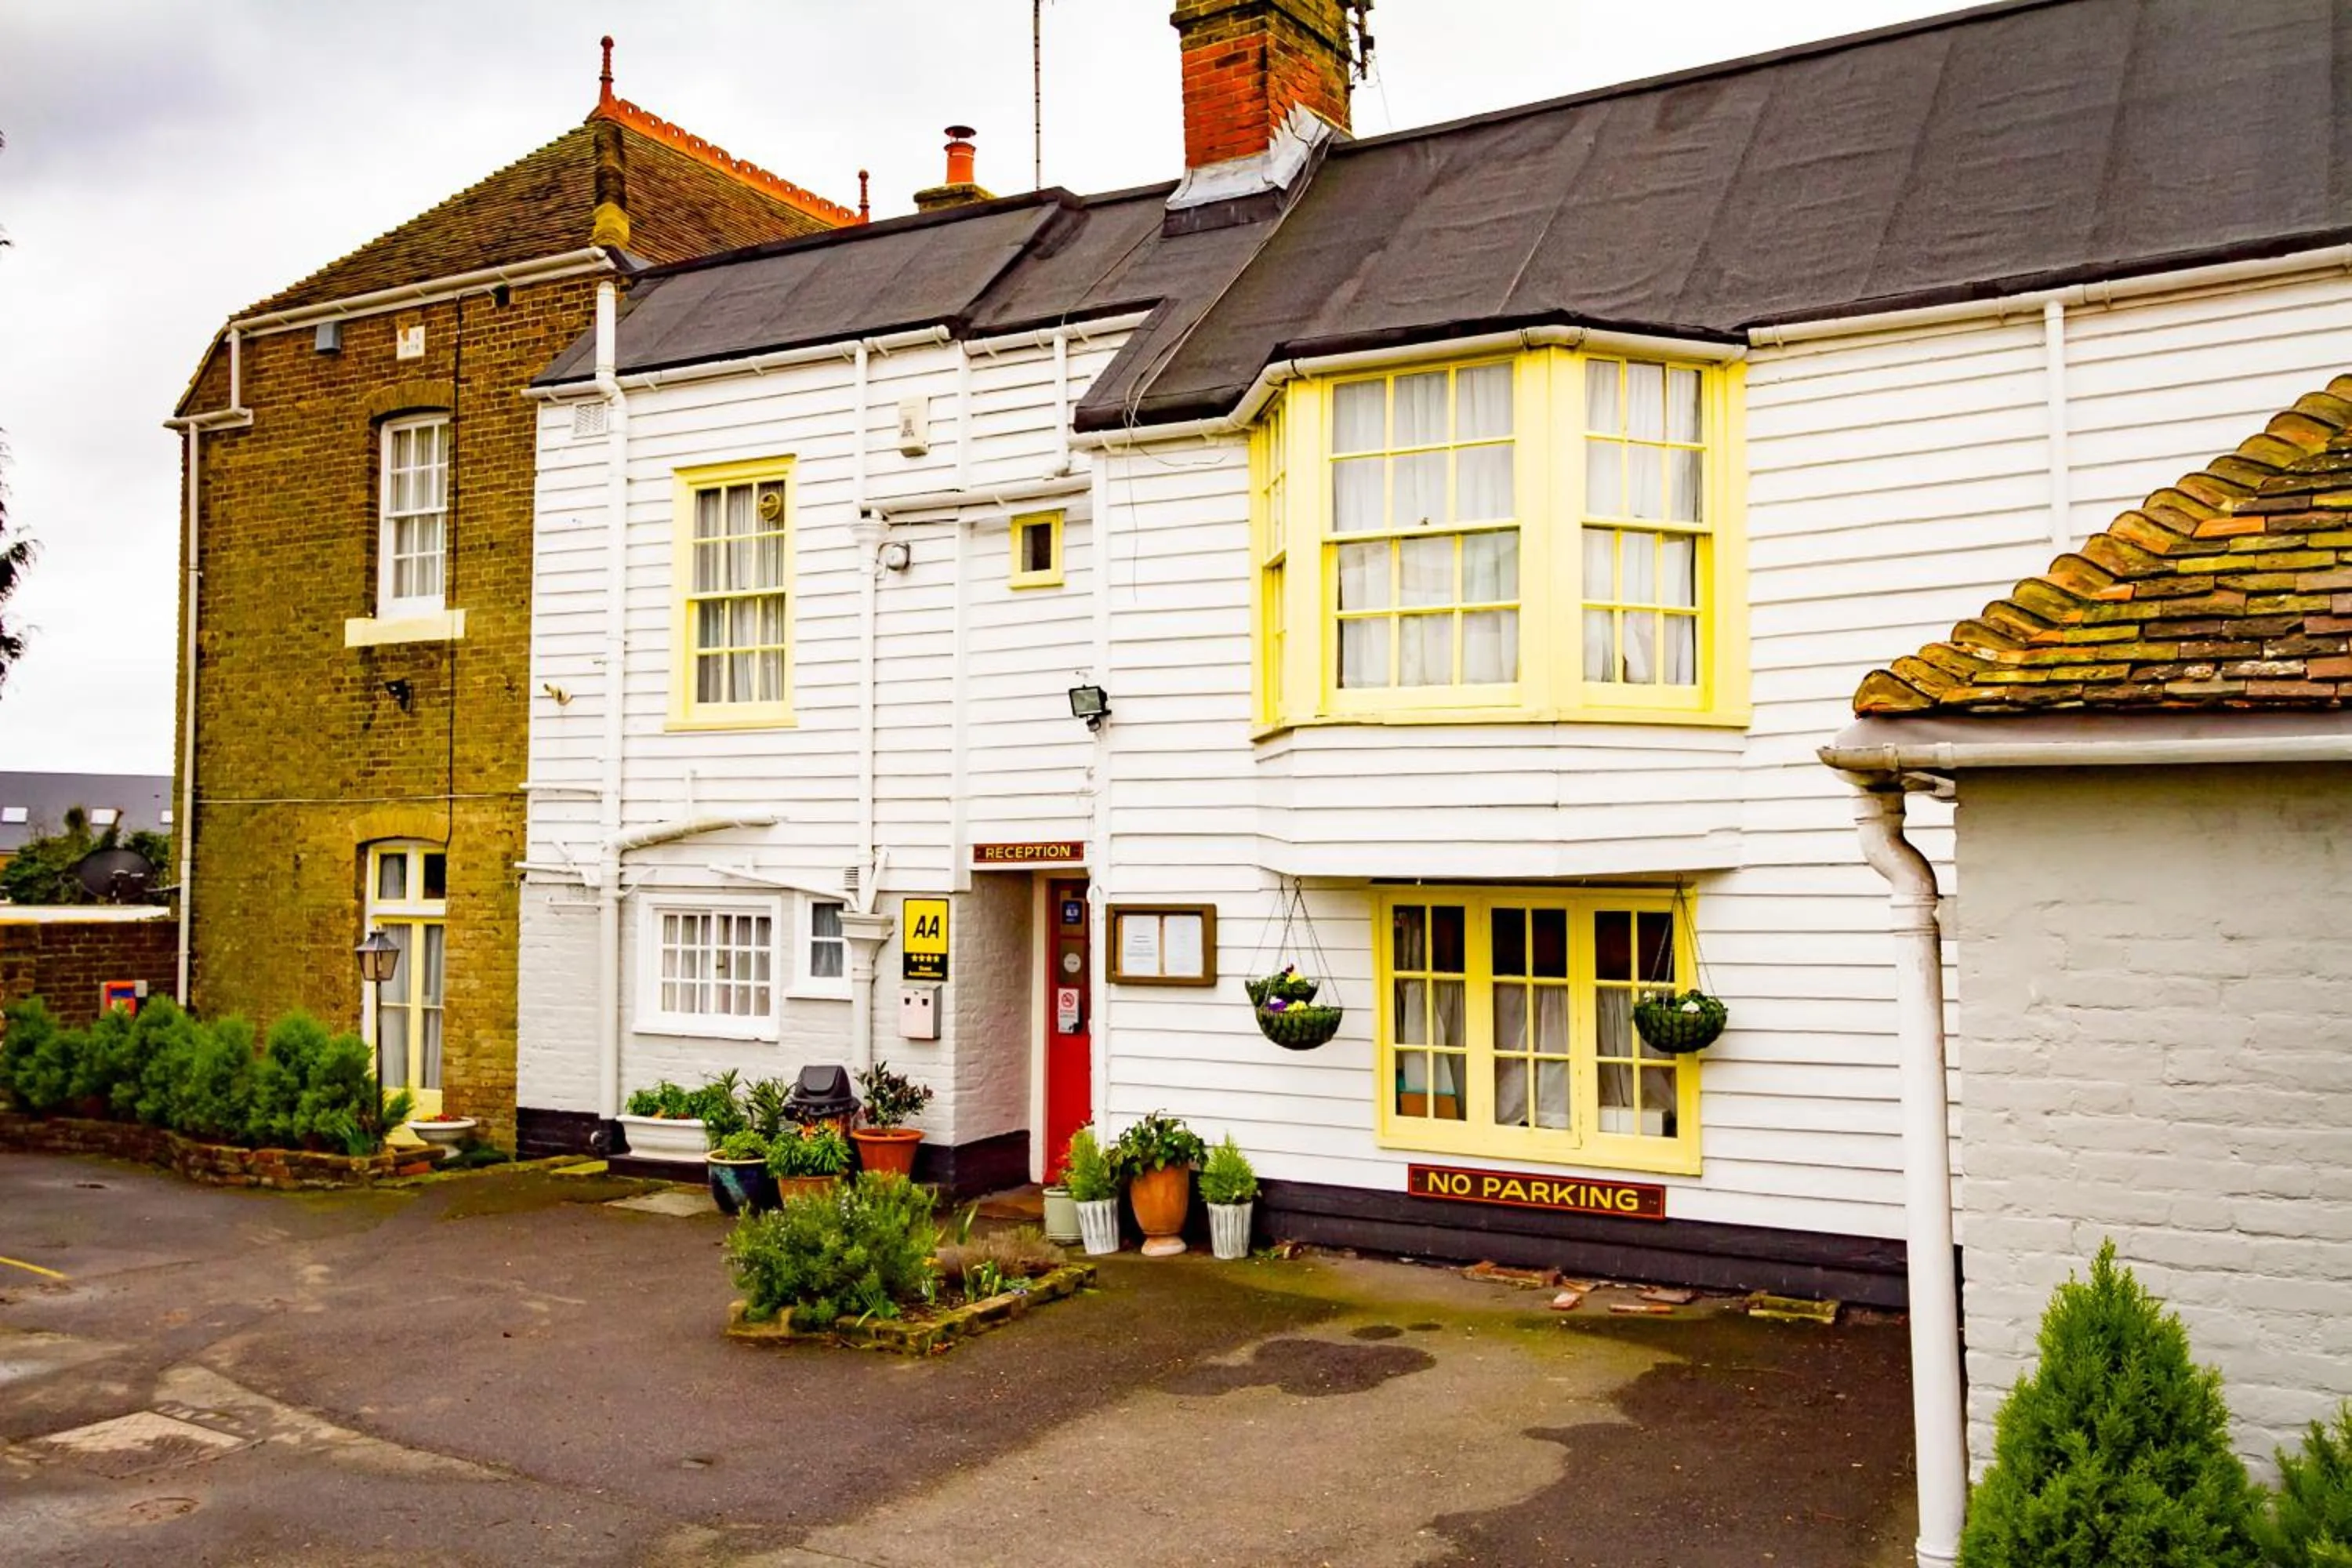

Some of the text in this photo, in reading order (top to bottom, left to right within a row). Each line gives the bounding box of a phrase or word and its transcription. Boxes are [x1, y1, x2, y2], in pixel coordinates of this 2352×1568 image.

[985, 844, 1071, 859] RECEPTION
[913, 915, 939, 938] AA
[1428, 1172, 1639, 1211] NO PARKING
